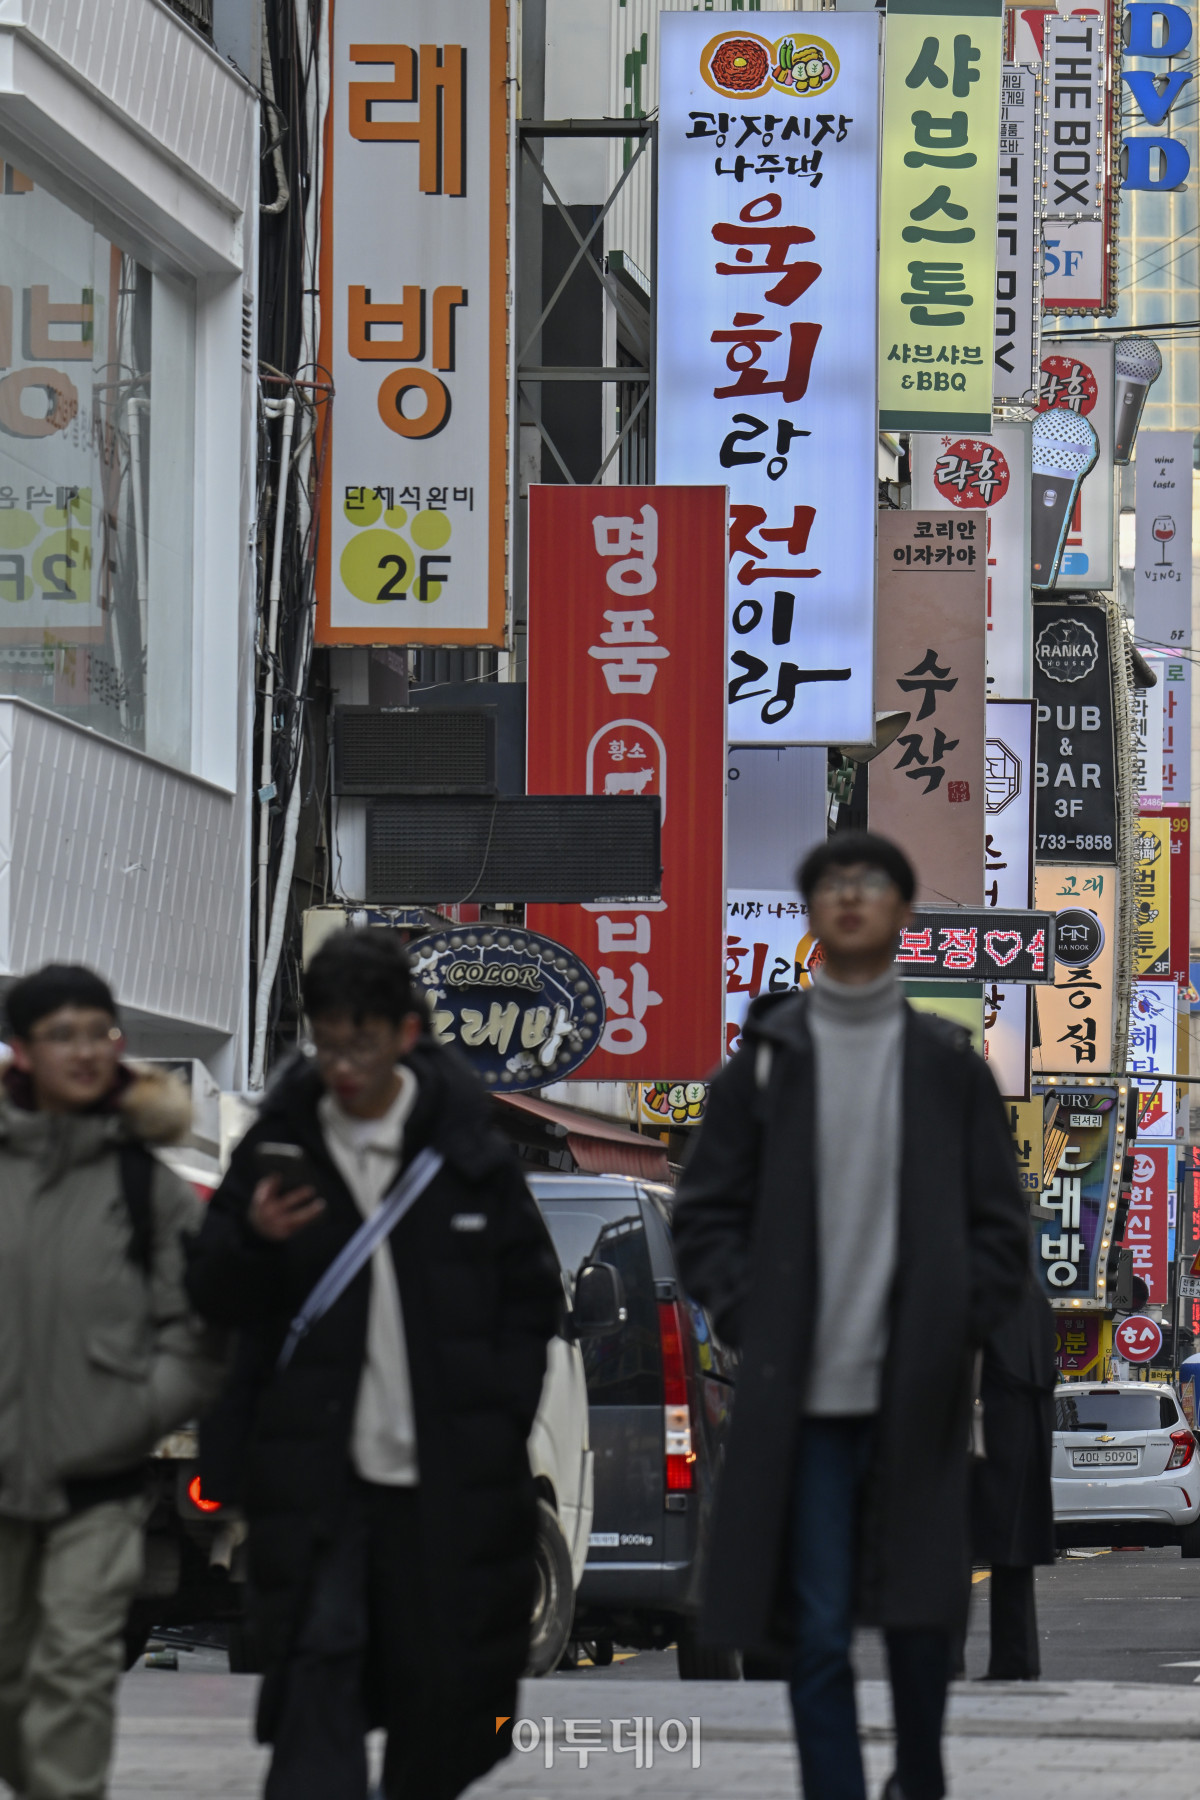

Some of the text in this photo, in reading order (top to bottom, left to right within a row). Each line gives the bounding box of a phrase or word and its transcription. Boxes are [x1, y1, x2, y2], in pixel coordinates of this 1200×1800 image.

[1055, 28, 1093, 109] THE
[1120, 3, 1193, 190] DVD
[685, 111, 854, 149] 광장시장
[715, 150, 824, 188] 나주댁
[1053, 121, 1091, 206] BOX
[899, 34, 982, 327] 샤브스톤
[710, 192, 824, 481] 육회랑
[887, 343, 984, 366] 샤브샤브
[900, 370, 967, 392] &BBQ
[936, 447, 1000, 506] 락휴
[1152, 480, 1176, 489] taste
[345, 485, 474, 511] 단체석완비
[914, 520, 977, 541] 코리안
[893, 545, 977, 566] 이자카야
[376, 554, 452, 602] 2F
[587, 503, 671, 695] 명품
[1041, 644, 1093, 658] RANKA
[892, 648, 960, 795] 수작
[1037, 705, 1102, 731] PUB
[607, 739, 648, 762] 황소
[1059, 737, 1073, 757] &
[1036, 763, 1101, 789] BAR
[1054, 799, 1083, 818] 3F
[447, 960, 544, 992] COLOR
[1154, 962, 1169, 972] 3F
[1072, 1115, 1101, 1126] 럭셔리
[1105, 1452, 1132, 1462] 5090
